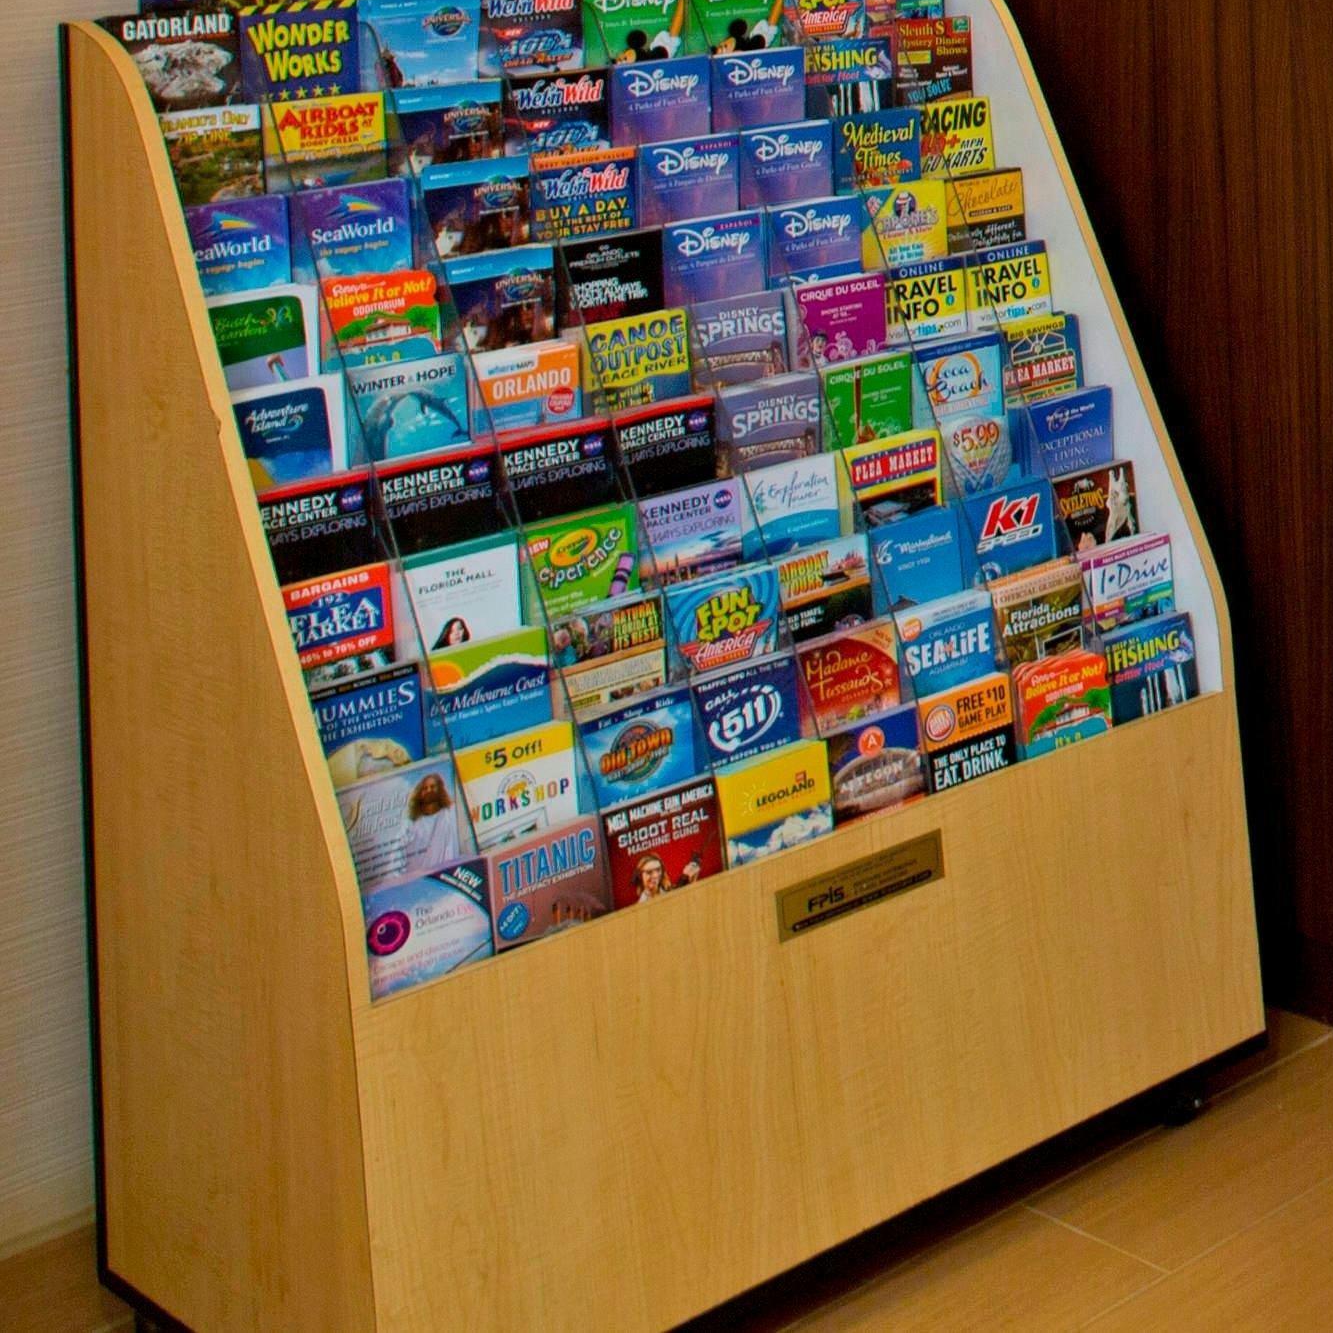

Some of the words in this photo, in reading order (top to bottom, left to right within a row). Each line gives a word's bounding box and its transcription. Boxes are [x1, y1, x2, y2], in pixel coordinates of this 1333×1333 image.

[123, 13, 230, 41] GATORLAND
[423, 13, 471, 27] UNIVERSAL
[801, 7, 847, 25] AMERICA
[249, 19, 350, 54] WONDER
[264, 49, 341, 82] WORKS
[279, 102, 380, 131] AIRBOAT
[299, 122, 360, 141] RIDES
[843, 118, 915, 150] Medieval
[855, 147, 902, 172] Times
[312, 217, 395, 244] SeaWorld
[574, 222, 601, 235] STAY
[603, 218, 632, 230] FREE
[899, 261, 945, 278] ONLINE
[987, 248, 1031, 263] ONLINE
[495, 273, 544, 291] UNIVERSAL
[886, 274, 957, 302] TRAVEL
[972, 259, 1042, 288] TRAVEL
[800, 286, 834, 303] CIRQUE
[836, 284, 849, 296] DU
[851, 279, 881, 293] SOLEIL
[977, 281, 1027, 309] INFO
[353, 297, 406, 318] ODDITORIUM
[719, 306, 758, 321] DISNEY
[887, 298, 940, 325] INFO
[589, 314, 685, 354] CANOE
[695, 312, 785, 346] SPRINGS
[1010, 329, 1026, 340] BIG
[1028, 321, 1065, 337] SAVINGS
[591, 334, 687, 375] OUTPOST
[352, 375, 406, 396] WINTER
[417, 365, 456, 382] HOPE
[493, 367, 571, 400] ORLANDO
[592, 368, 639, 387] PEACE
[645, 357, 687, 374] RIVER
[830, 370, 862, 386] CIRQUE
[862, 367, 876, 378] DU
[878, 360, 906, 374] SOLEIL
[1004, 364, 1030, 385] FLEA
[1031, 356, 1075, 380] MARKET
[246, 402, 309, 424] Adventure
[758, 393, 796, 408] DISNEY
[250, 416, 288, 435] Island
[620, 412, 686, 443] KENNEDY
[733, 398, 820, 439] SPRINGS
[503, 439, 580, 469] KENNEDY
[505, 461, 536, 477] SPACE
[537, 451, 580, 469] CENTER
[855, 461, 883, 483] FLEA
[888, 446, 934, 473] MARKET
[382, 464, 464, 494] KENNEDY
[384, 487, 416, 504] SPACE
[418, 477, 465, 496] CENTER
[260, 493, 338, 522] ENNEDY
[642, 494, 710, 523] KENNEDY
[982, 492, 1041, 540] K1
[1060, 488, 1105, 516] SKELETONS
[300, 515, 368, 540] EXPLORING
[445, 568, 468, 579] THE
[779, 549, 829, 583] AIRBOAT
[291, 571, 369, 602] BARGAINS
[418, 578, 463, 596] FLORIDA
[464, 571, 495, 583] MALL
[317, 593, 344, 607] 192
[696, 586, 751, 623] FUN
[1010, 602, 1050, 623] Florida
[289, 596, 379, 635] FLEA
[697, 603, 761, 642] SPOT
[1003, 604, 1081, 637] Attractions
[696, 628, 755, 662] AMERICA
[1112, 629, 1180, 674] FISHING
[805, 648, 873, 682] Madame
[450, 686, 514, 710] Melbourne
[516, 672, 546, 693] Coast
[810, 665, 884, 703] Tussauds
[705, 688, 740, 711] CALL
[956, 692, 985, 714] FREE
[986, 684, 1006, 703] $10
[721, 692, 768, 738] 511
[957, 712, 980, 727] GAME
[981, 705, 1007, 721] PLAY
[485, 747, 508, 769] $5
[511, 740, 543, 761] Off!
[934, 754, 949, 770] THE
[949, 747, 969, 765] ONLY
[970, 739, 995, 757] PLACE
[995, 733, 1006, 747] TO
[839, 758, 905, 793] ARTEGON
[935, 766, 962, 790] EAT.
[963, 748, 1009, 780] DRINK.
[472, 777, 570, 823] WORKSHOP
[756, 778, 815, 807] LEGOLAND
[617, 820, 667, 848] SHOOT
[672, 807, 709, 830] REAL
[627, 833, 670, 856] MACHINE
[672, 824, 700, 840] GUNS
[498, 828, 596, 896] TITANIC
[454, 867, 484, 891] NEW
